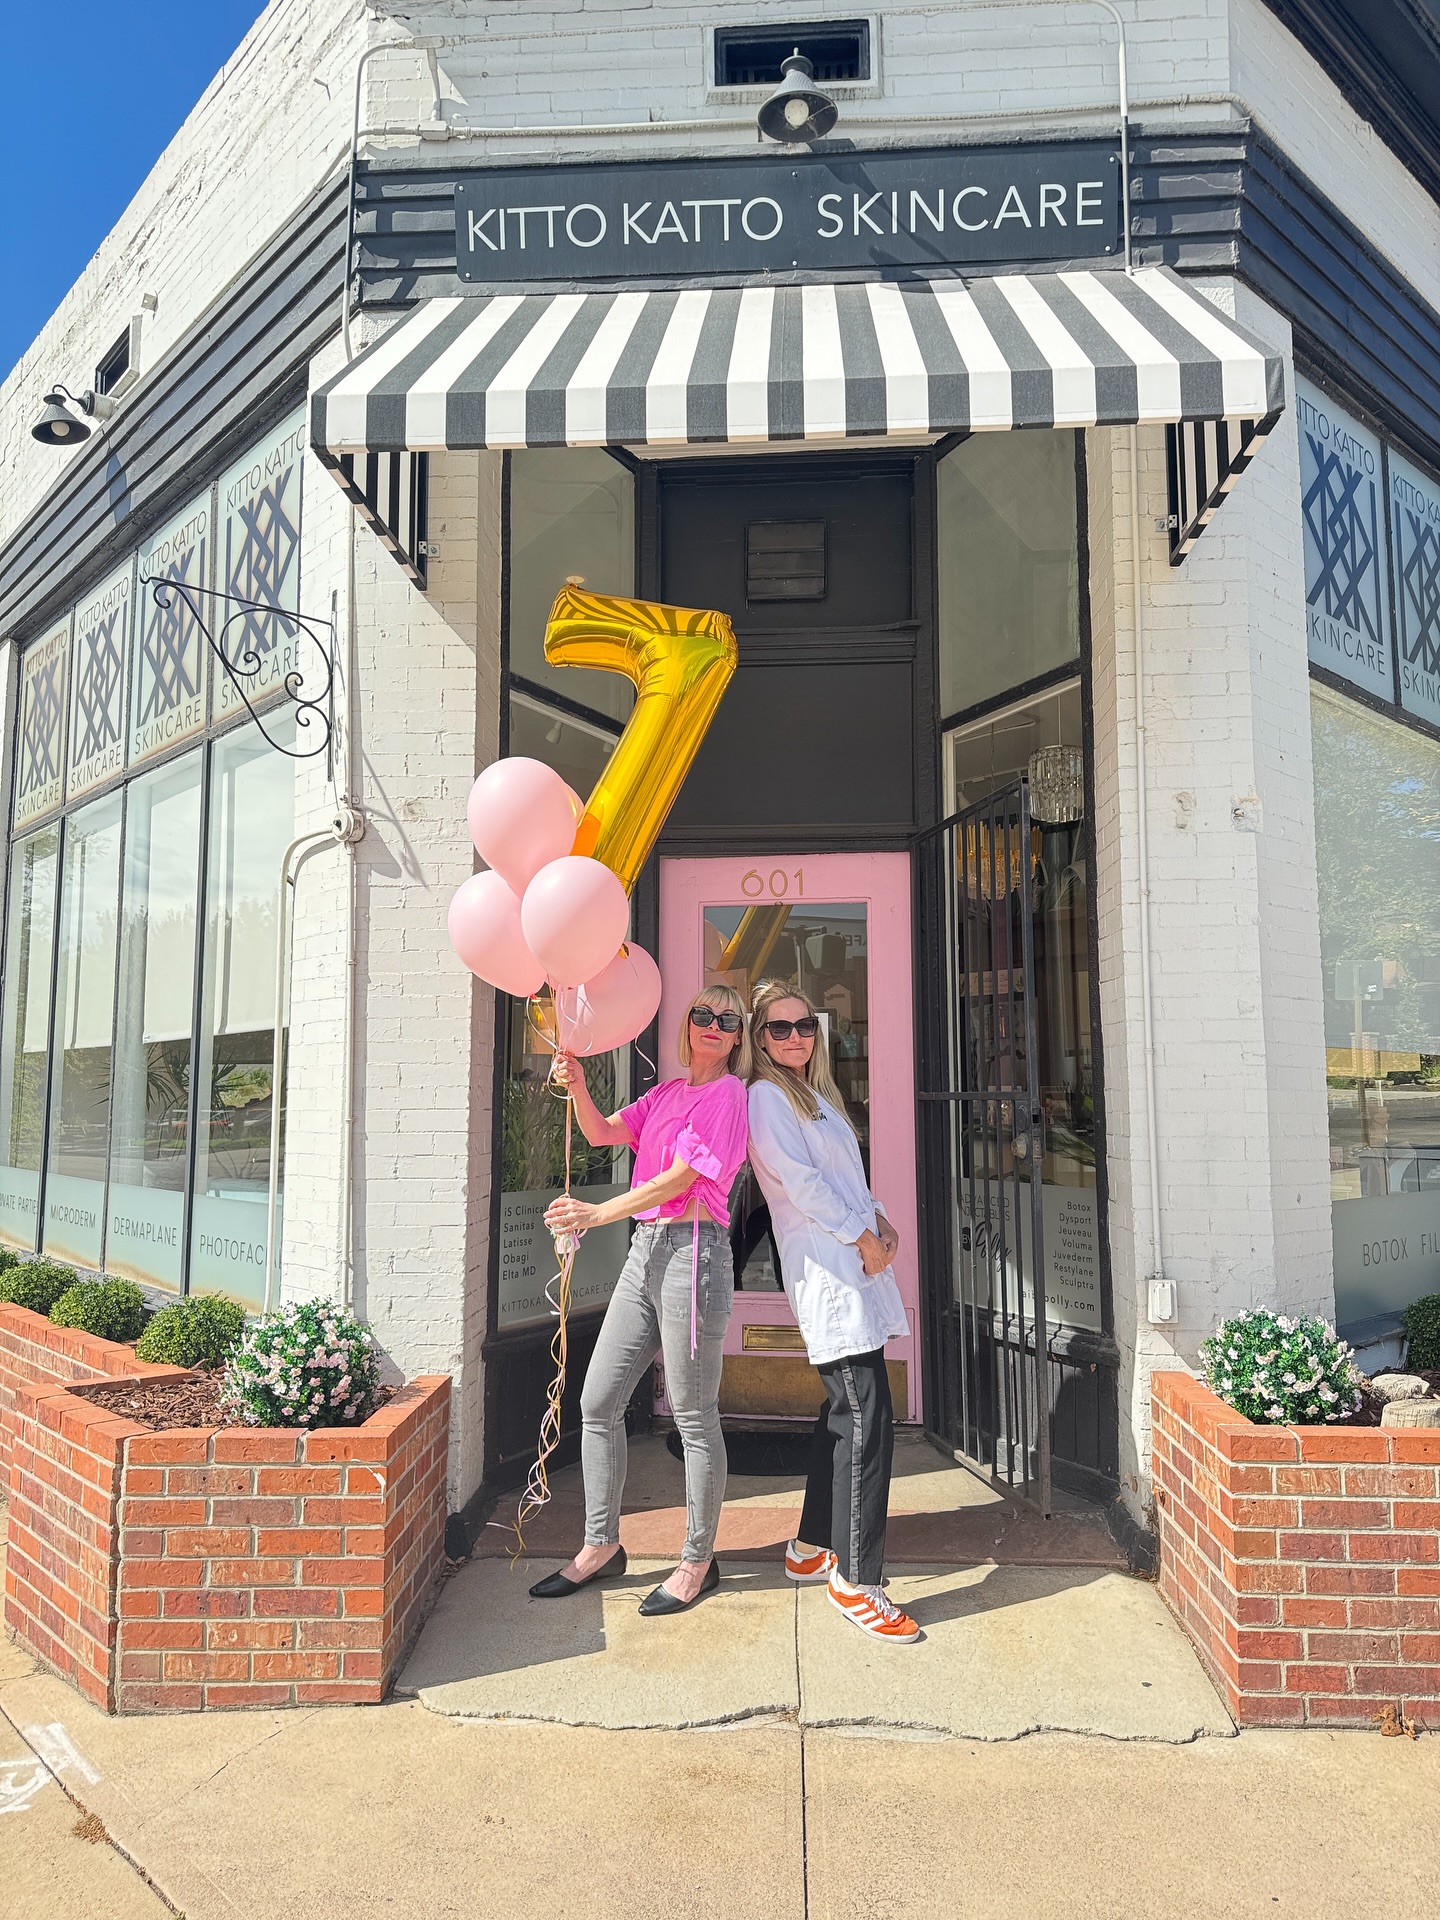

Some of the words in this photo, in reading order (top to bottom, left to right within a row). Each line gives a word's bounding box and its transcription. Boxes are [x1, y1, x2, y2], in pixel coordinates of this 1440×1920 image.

[467, 202, 606, 253] KITTO
[623, 196, 784, 246] KATTO
[817, 181, 1105, 240] SKINCARE
[1333, 423, 1375, 475] KATTO
[226, 464, 262, 512] KITTO
[264, 424, 305, 480] KATTO
[1392, 471, 1426, 514] KITTO
[142, 541, 170, 578] KITTO
[172, 510, 207, 557] KATTO
[79, 601, 100, 635] KITTO
[102, 576, 129, 615] KATTO
[26, 648, 44, 678] KITTO
[45, 629, 68, 664] KATTO
[1306, 612, 1386, 676] KINCARE
[221, 640, 300, 708] SKINCARE
[134, 699, 201, 755] SKINCARE
[70, 744, 121, 792] SKINCARE
[17, 781, 60, 820] SKINCARE
[740, 868, 804, 897] 601
[50, 1204, 96, 1229] MICRODERM
[504, 1207, 512, 1217] iS
[515, 1203, 547, 1216] Clinical
[1059, 1213, 1092, 1225] Dysport
[1067, 1201, 1091, 1212] Botox
[113, 1216, 177, 1247] DERMAPLANE
[503, 1222, 535, 1233] Sanitas
[1058, 1225, 1092, 1238] Jeuveau
[503, 1237, 533, 1249] Latisse
[1052, 1251, 1093, 1264] Juvederm
[1062, 1238, 1093, 1251] Voluma
[1362, 1237, 1409, 1267] BOTOX
[502, 1270, 519, 1281] Elta
[522, 1265, 537, 1277] MD
[503, 1253, 530, 1265] Obagi
[1054, 1262, 1094, 1277] Restylane
[1059, 1276, 1094, 1290] Sculptra
